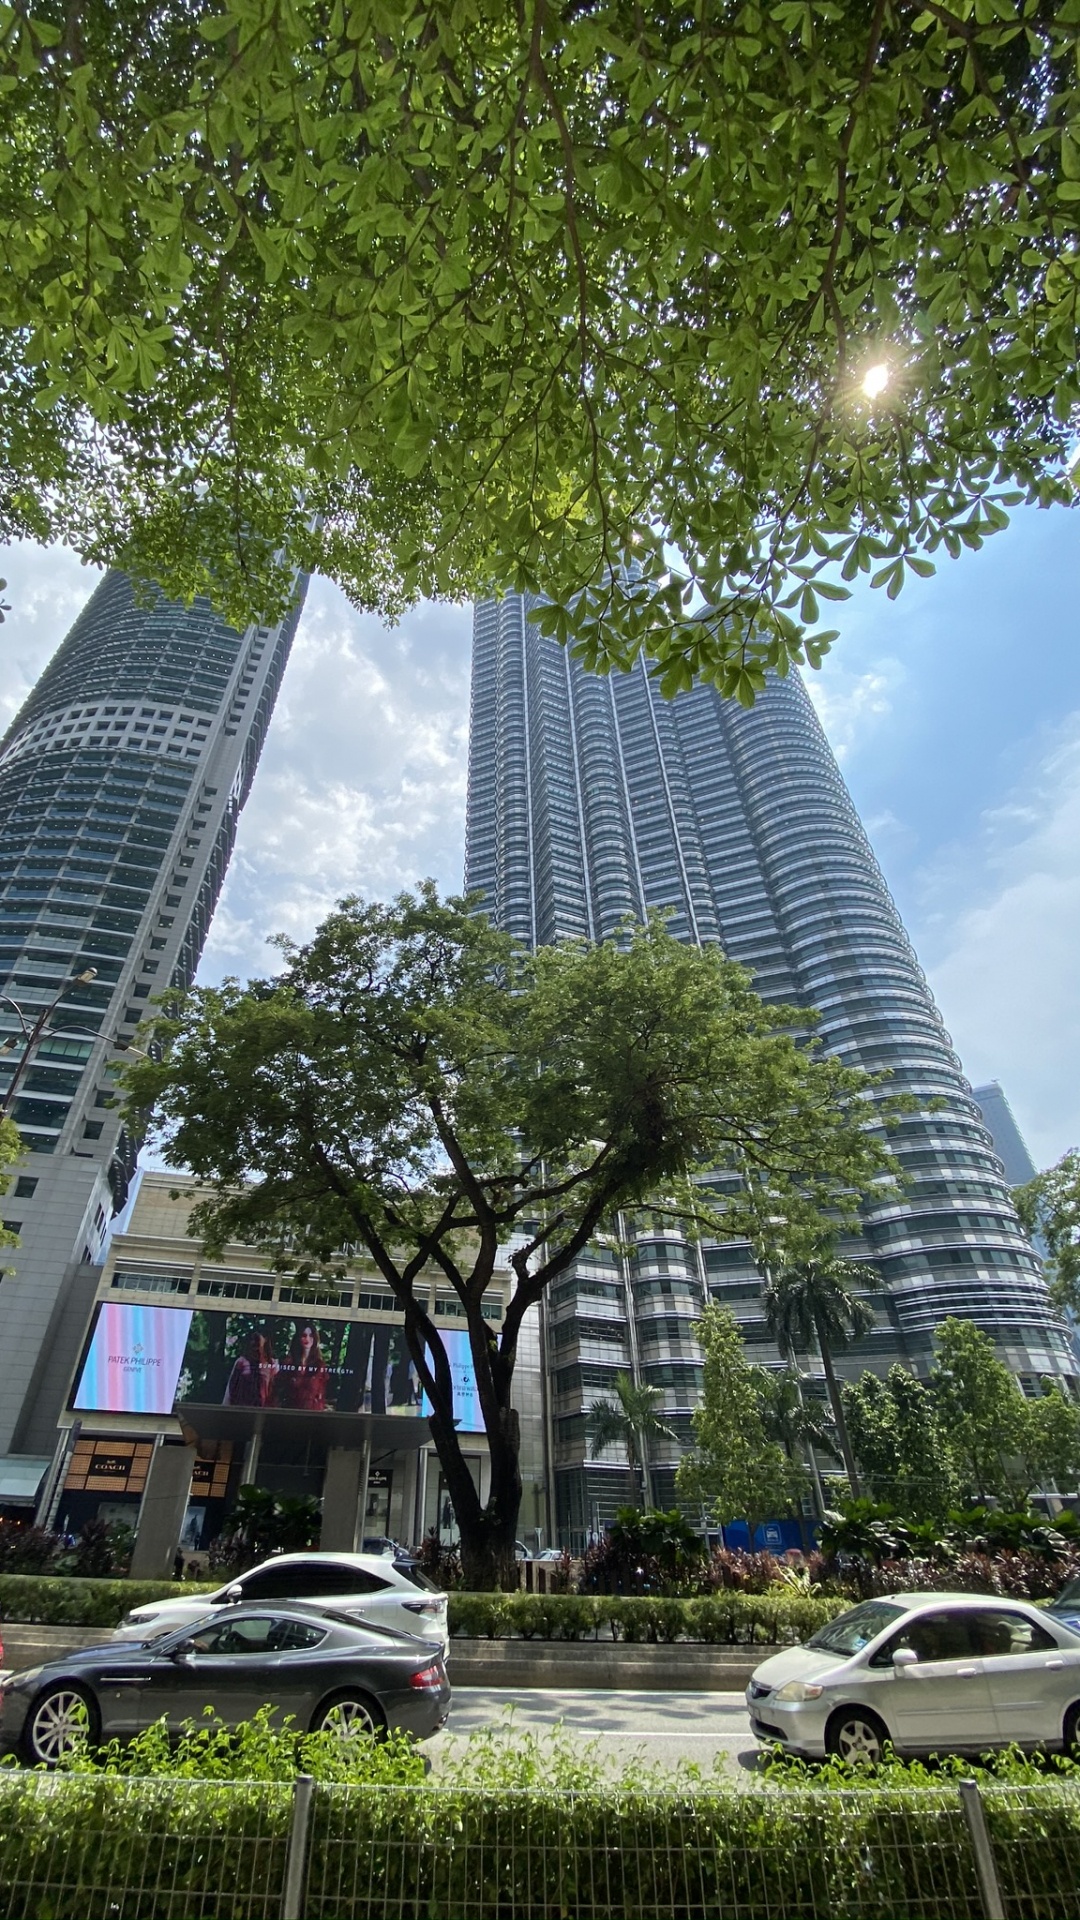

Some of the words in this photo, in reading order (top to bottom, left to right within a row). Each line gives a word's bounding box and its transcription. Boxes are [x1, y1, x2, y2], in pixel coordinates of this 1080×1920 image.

[108, 1355, 130, 1364] PATEK
[130, 1357, 162, 1366] PHILIPPE
[258, 1363, 296, 1371] SURPRISED
[95, 1463, 126, 1471] COACH
